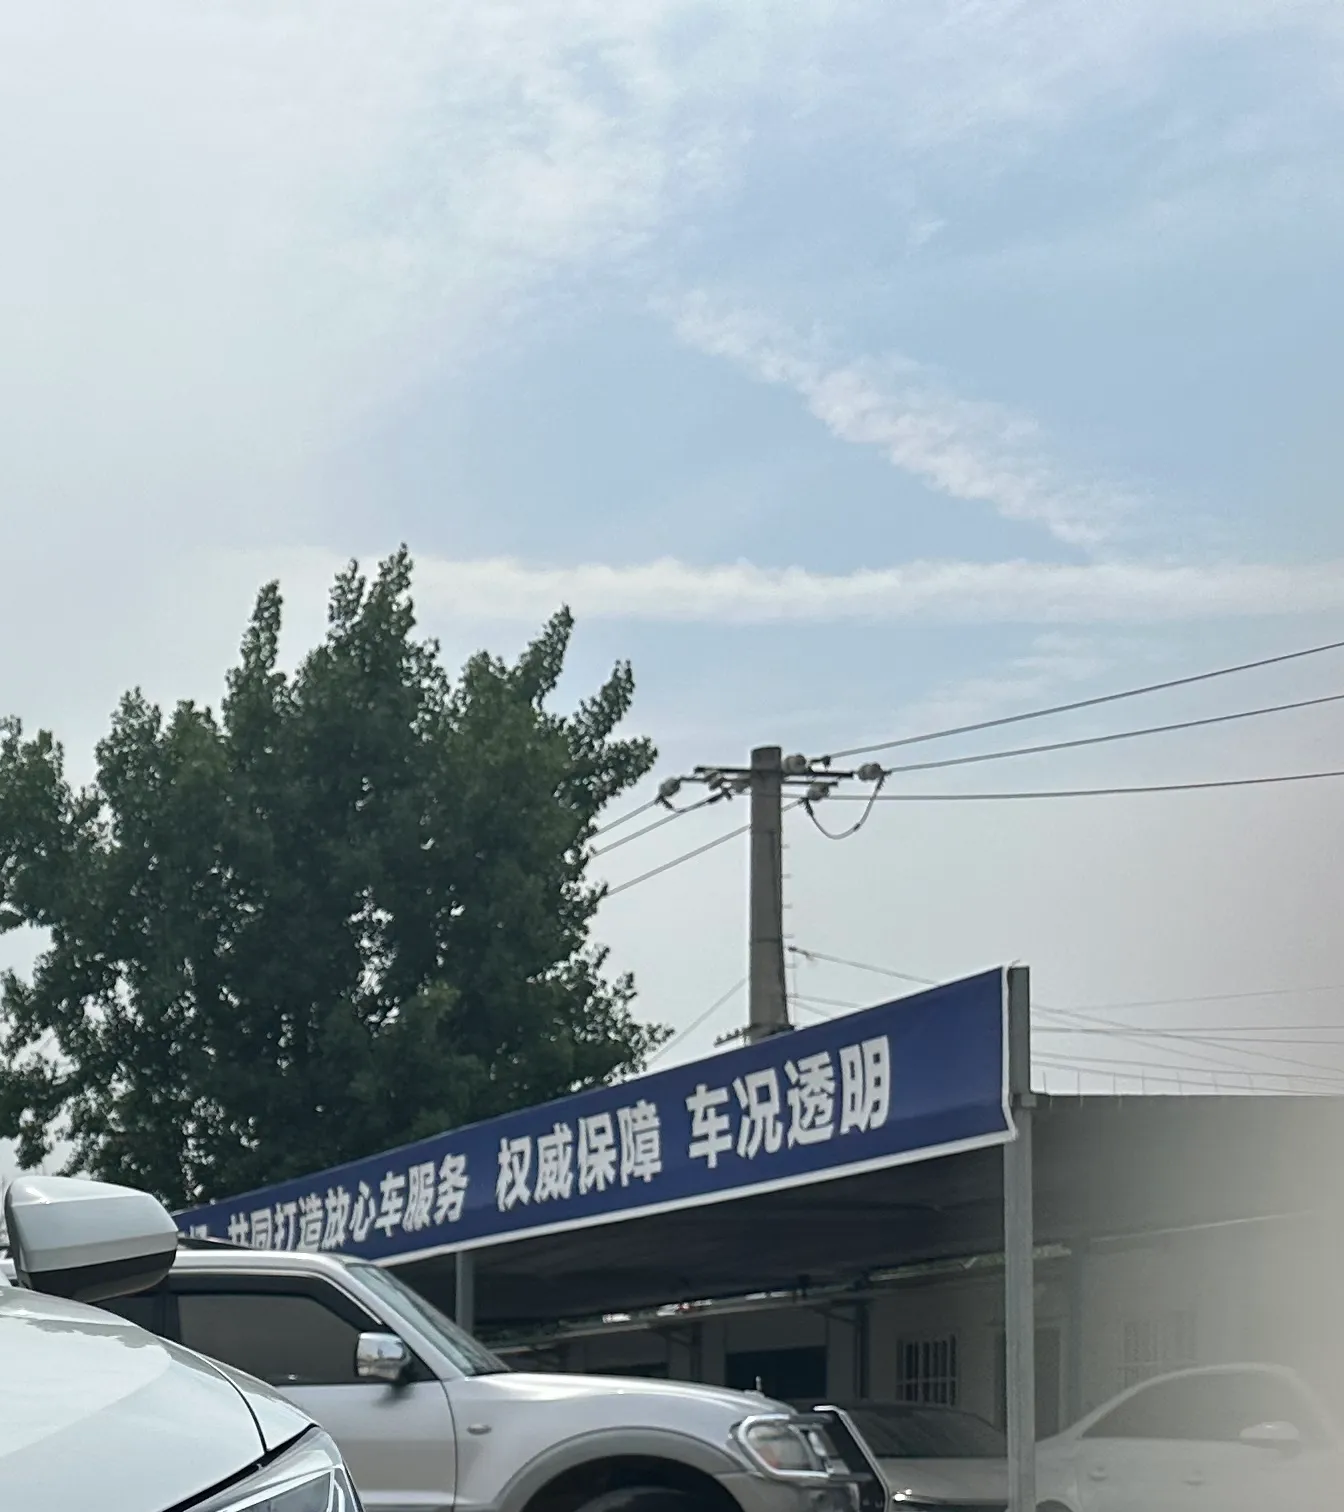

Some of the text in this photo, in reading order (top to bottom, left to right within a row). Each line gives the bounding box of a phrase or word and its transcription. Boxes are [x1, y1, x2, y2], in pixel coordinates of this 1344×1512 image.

[227, 1035, 891, 1251] 共同打造放心车服务 权威保障 车况透明
